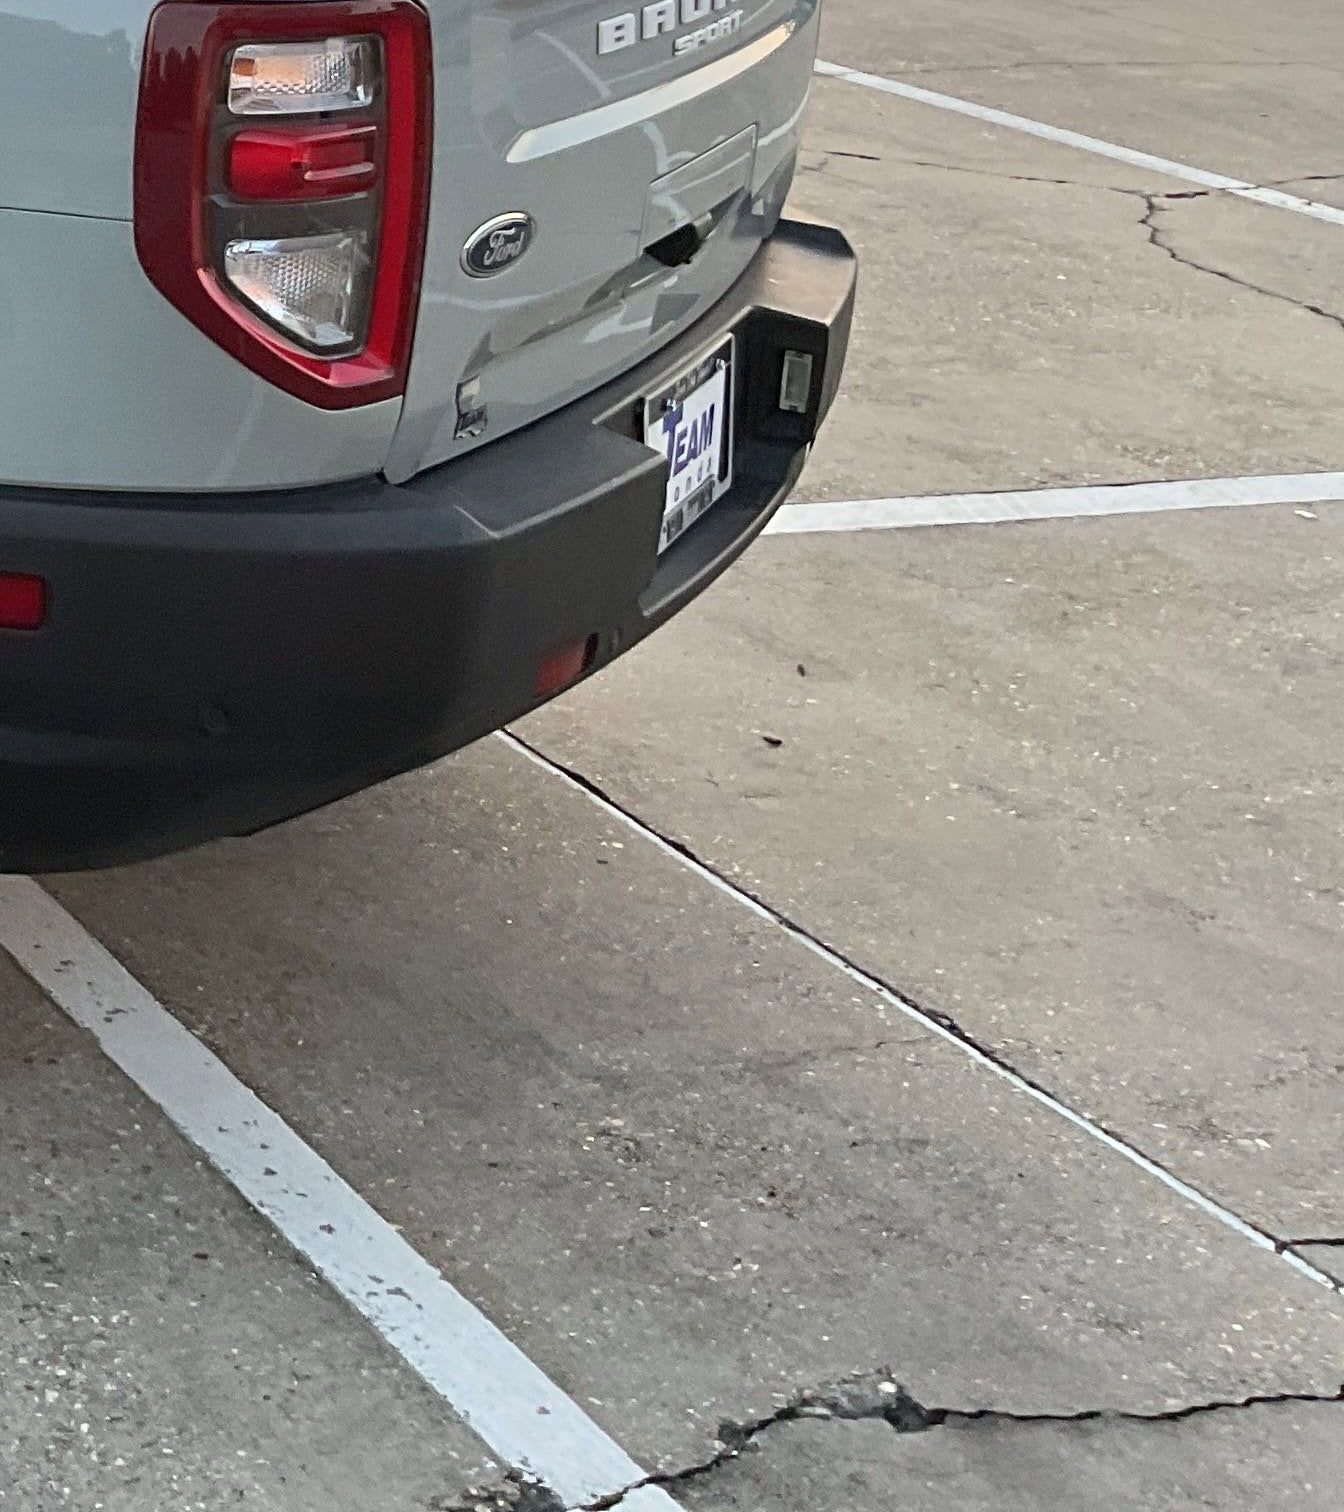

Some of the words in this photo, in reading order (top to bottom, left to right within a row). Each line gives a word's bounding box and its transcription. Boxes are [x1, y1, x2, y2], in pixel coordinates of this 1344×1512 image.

[672, 9, 743, 56] SPORT
[483, 227, 525, 265] Ford
[662, 400, 715, 478] TEAM
